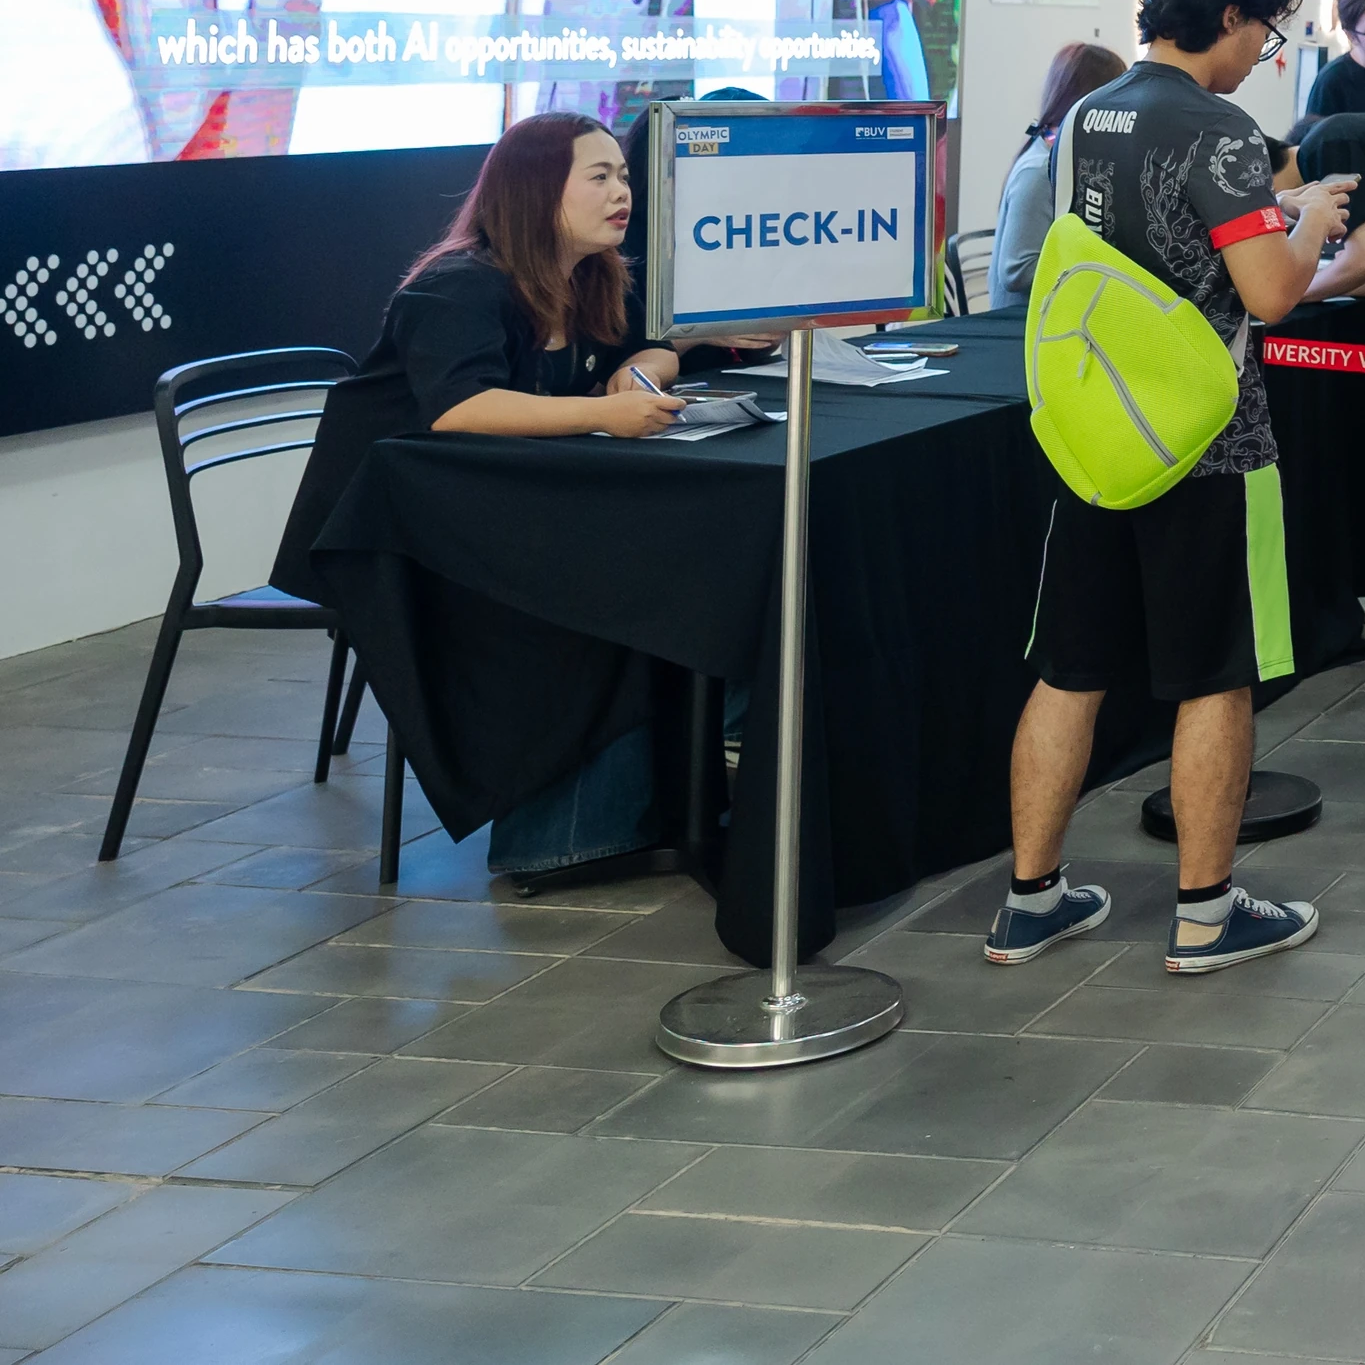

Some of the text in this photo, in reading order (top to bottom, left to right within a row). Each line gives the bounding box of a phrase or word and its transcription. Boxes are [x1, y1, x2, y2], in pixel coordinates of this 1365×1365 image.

[157, 18, 258, 64] which
[267, 18, 320, 64] has
[327, 20, 397, 63] both
[402, 21, 439, 62] AI
[445, 26, 617, 76] opportunities,
[864, 126, 886, 137] BUV
[1082, 108, 1138, 134] QUANG
[678, 129, 728, 141] OLYMPIC
[693, 143, 715, 153] DAY
[693, 207, 898, 251] CHECK-IN
[1263, 342, 1353, 367] IVERSITY
